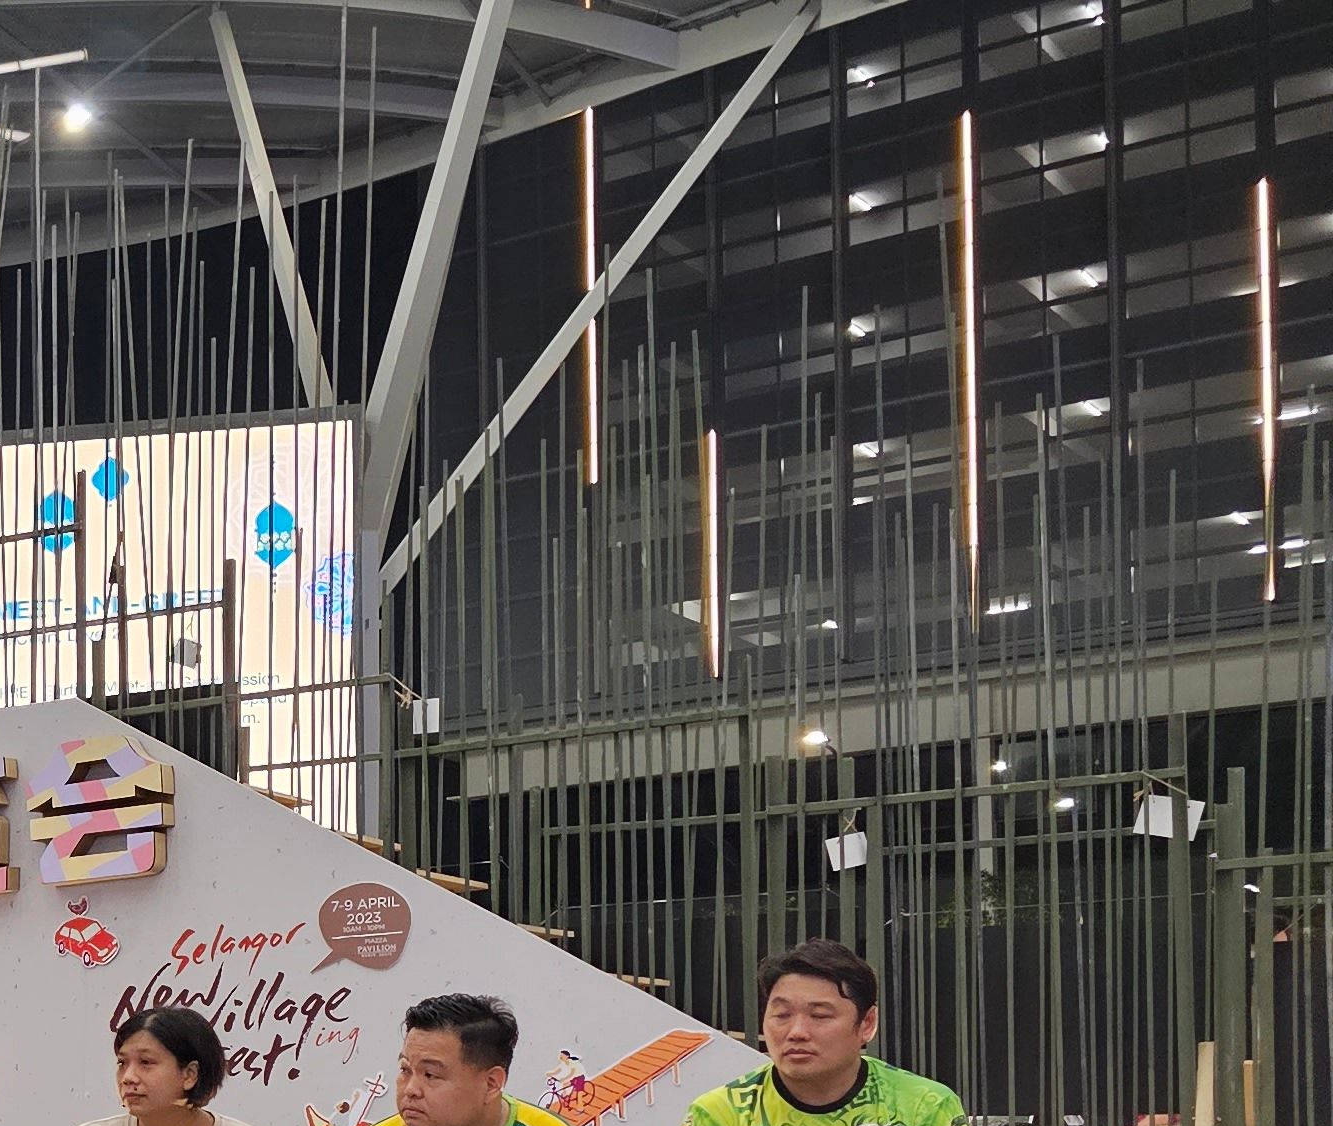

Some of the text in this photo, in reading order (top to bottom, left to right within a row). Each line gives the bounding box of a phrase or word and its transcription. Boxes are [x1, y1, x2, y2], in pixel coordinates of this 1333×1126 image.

[331, 896, 400, 912] 7-9 APRIL
[346, 911, 382, 925] 2023
[171, 922, 307, 977] Selangor
[357, 944, 397, 954] PAVILION
[109, 962, 224, 1032] New
[224, 1033, 301, 1086] est!
[314, 1026, 361, 1064] ing
